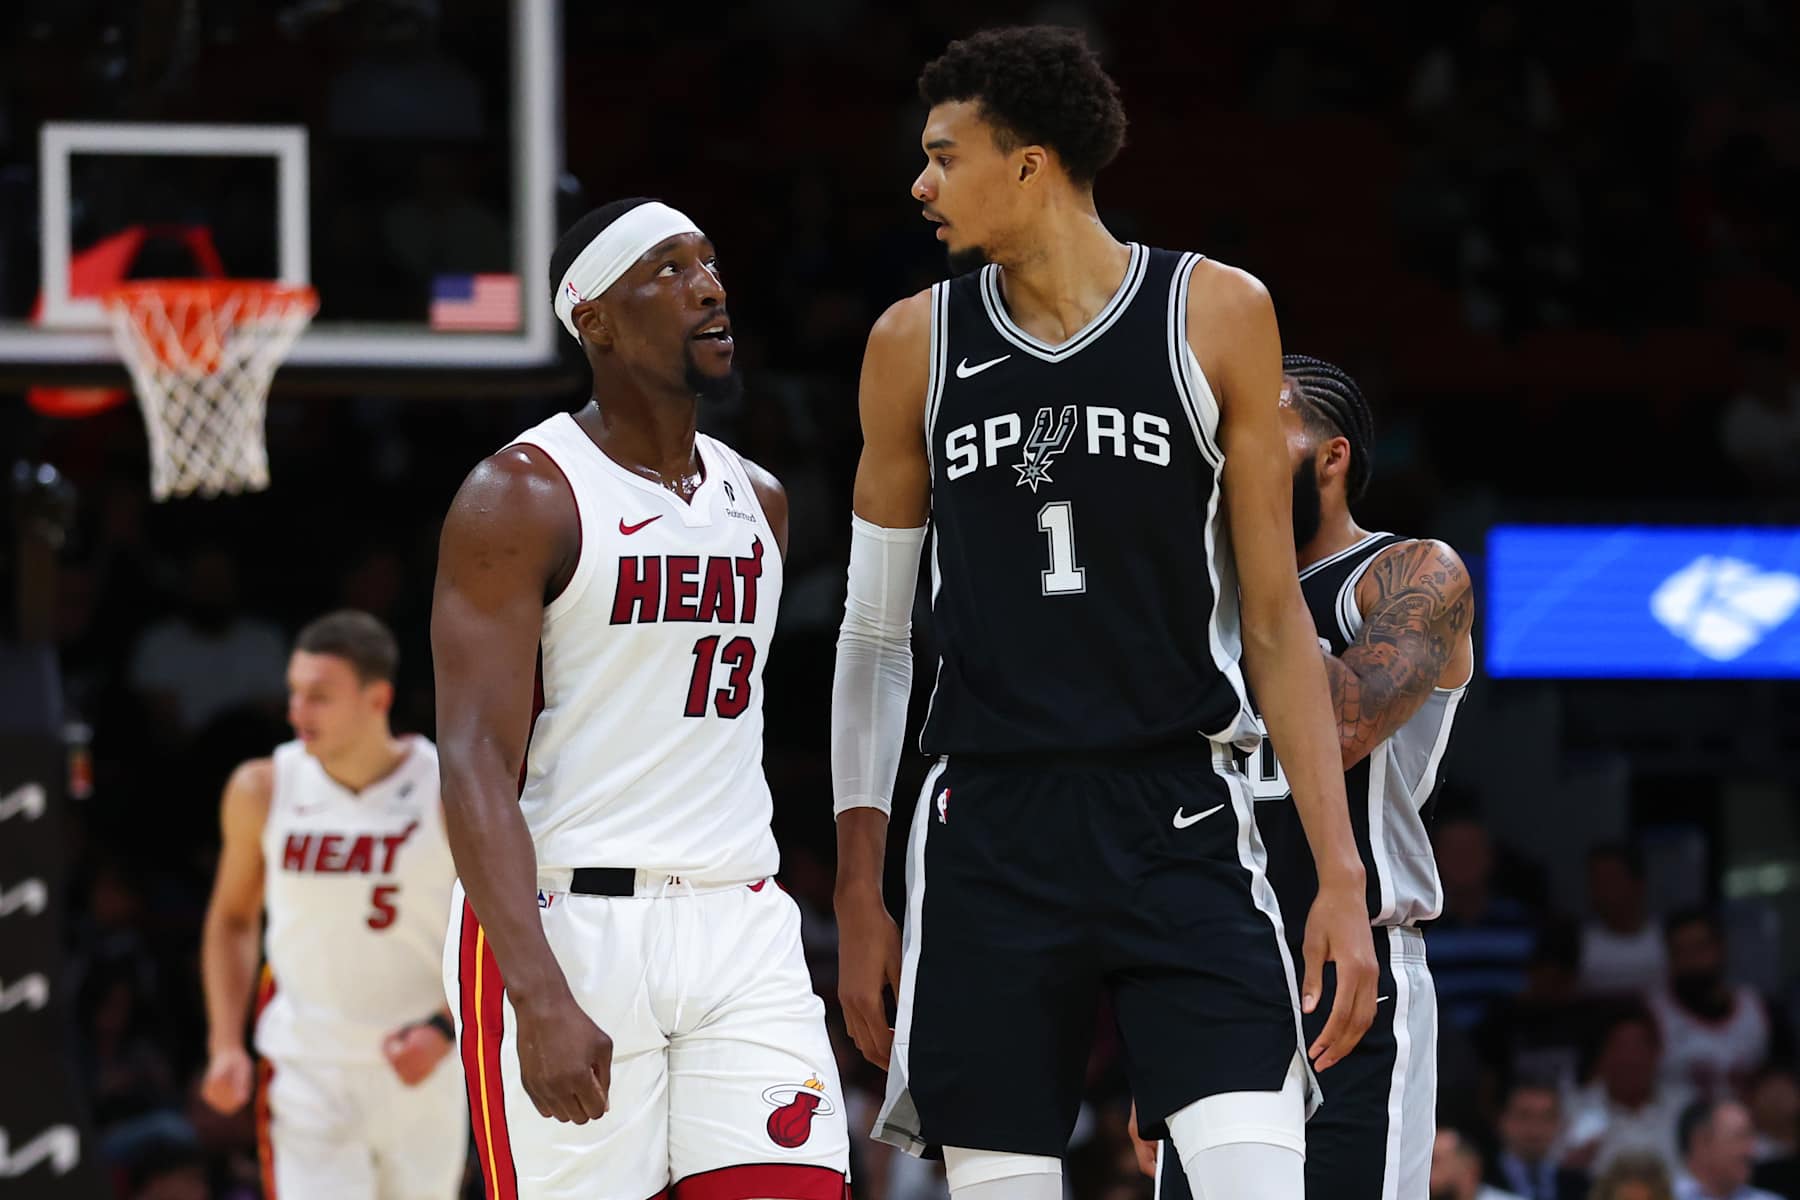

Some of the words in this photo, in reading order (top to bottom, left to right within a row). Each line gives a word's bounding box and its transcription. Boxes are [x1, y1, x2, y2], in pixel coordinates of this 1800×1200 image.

[946, 405, 1171, 493] SPURS
[610, 534, 764, 625] HEAT
[1036, 500, 1086, 596] 1
[684, 634, 756, 720] 13
[282, 819, 419, 874] HEAT
[367, 884, 400, 931] 5
